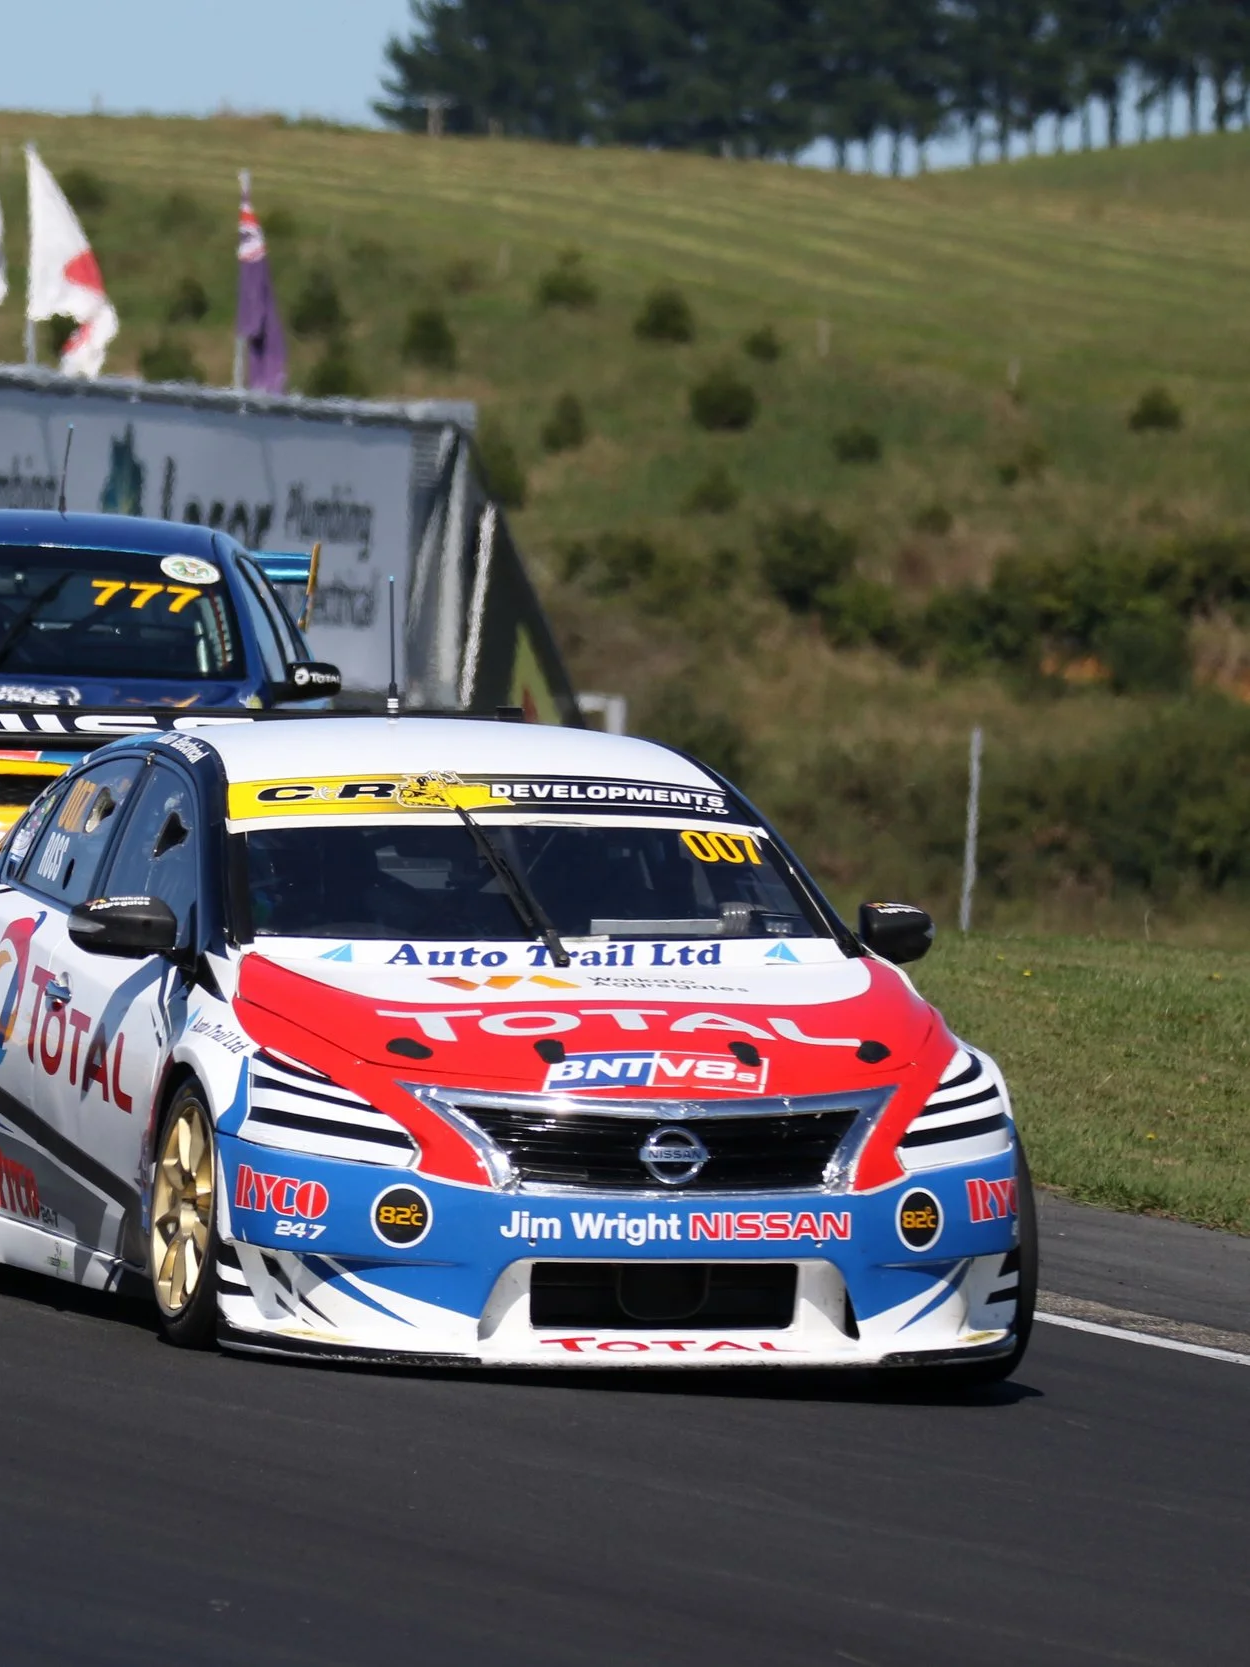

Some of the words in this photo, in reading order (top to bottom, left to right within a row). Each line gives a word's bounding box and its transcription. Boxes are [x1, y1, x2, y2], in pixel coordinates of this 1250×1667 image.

[91, 579, 203, 614] 777
[489, 783, 726, 808] DEVELOPMENTS
[694, 805, 730, 815] LTD
[679, 831, 762, 866] 007
[386, 943, 509, 967] Auto
[526, 943, 636, 967] Tail
[648, 943, 723, 967] Ltd
[587, 976, 696, 986] Waikato
[592, 981, 749, 993] Aggregates
[27, 965, 133, 1114] TOTAL
[376, 1008, 861, 1047] TOTAL
[549, 1056, 654, 1082] BNT
[647, 1149, 702, 1160] NISSAN
[235, 1163, 330, 1220] RYCO
[500, 1211, 562, 1239] Jim
[571, 1212, 682, 1246] Wright
[689, 1212, 852, 1241] NISSAN
[540, 1336, 810, 1353] TOTAL
